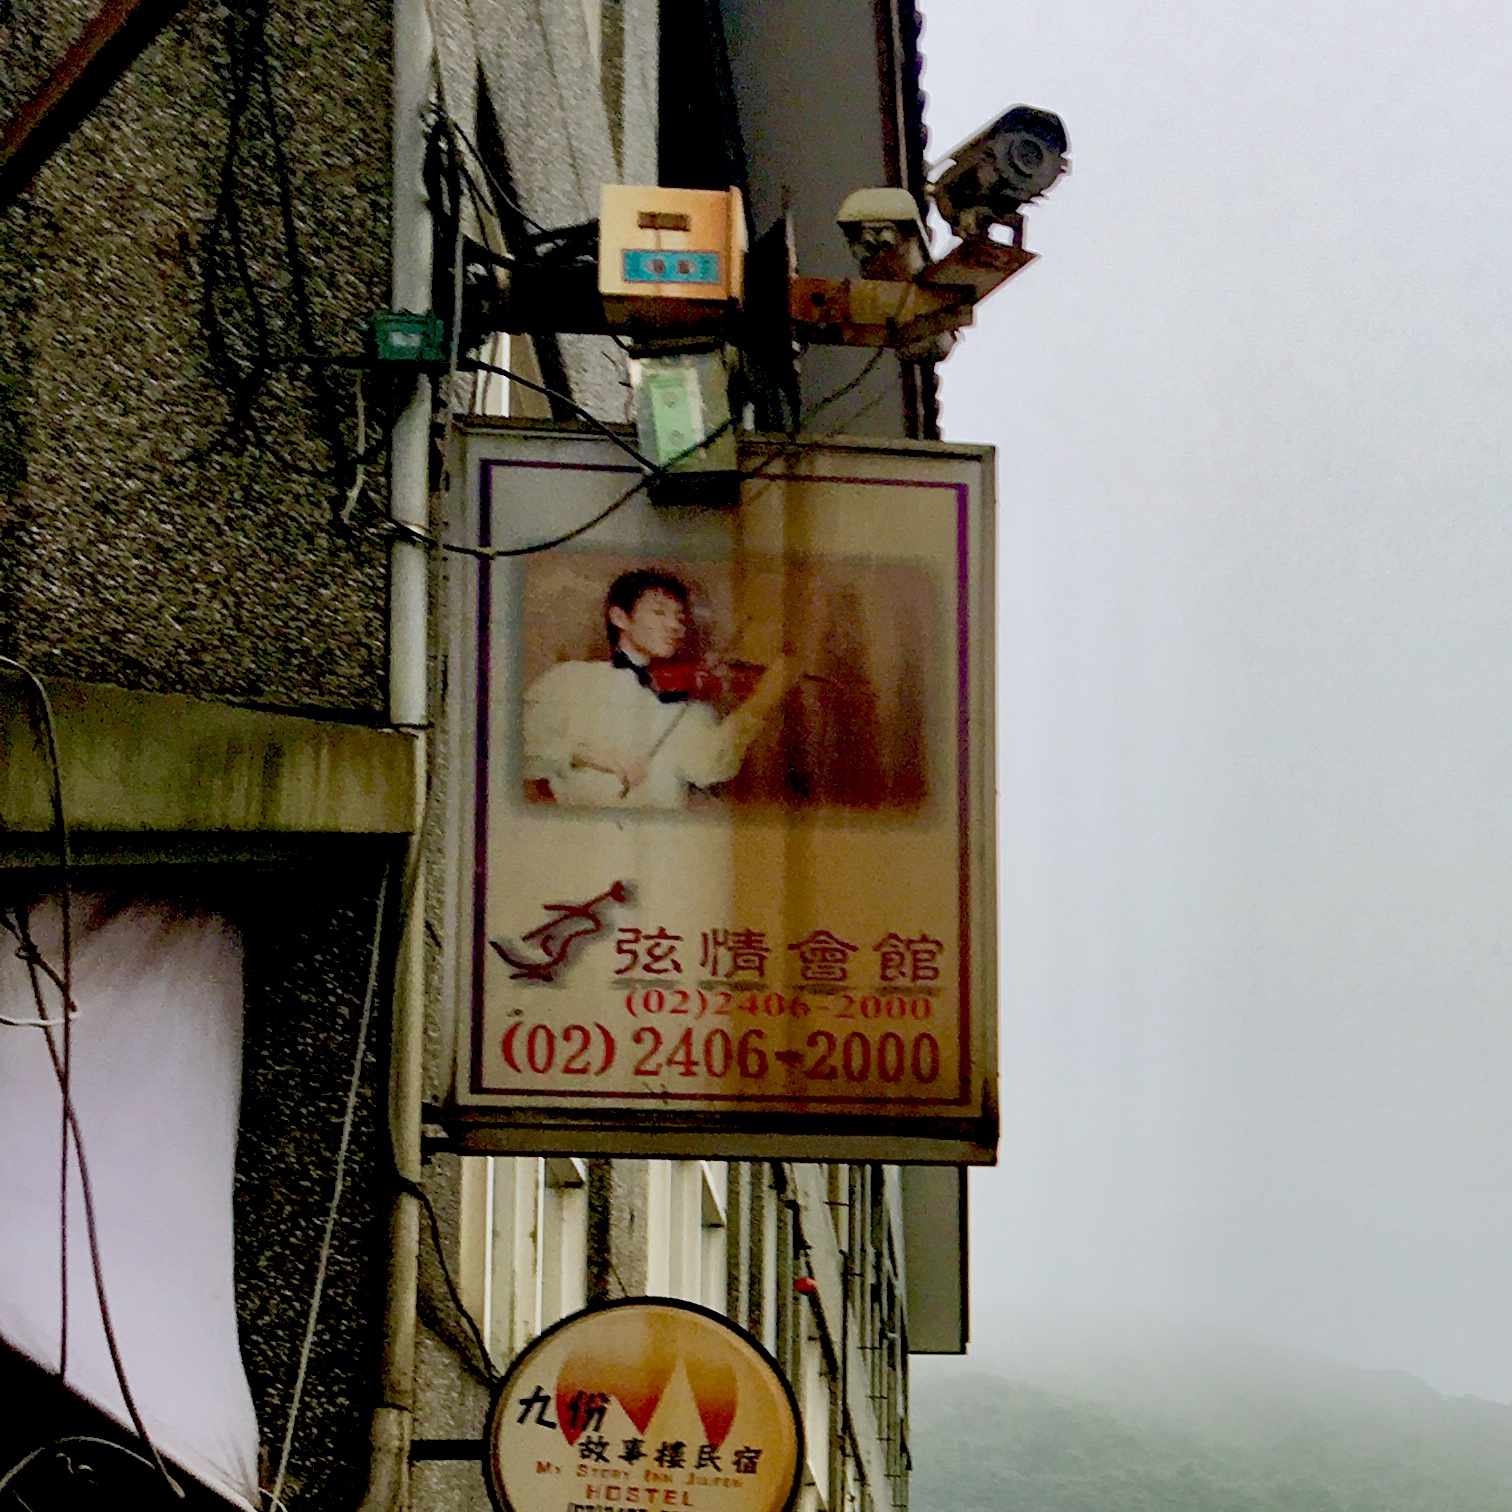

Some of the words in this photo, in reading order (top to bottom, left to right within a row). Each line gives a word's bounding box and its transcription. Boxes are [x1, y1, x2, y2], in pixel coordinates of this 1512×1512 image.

[614, 926, 945, 984] 弦情會館
[624, 988, 934, 1020] (02)2406-2000
[515, 1384, 613, 1433] 九份
[577, 1435, 763, 1475] 故事樓民宿
[585, 1484, 694, 1507] HOSTEL
